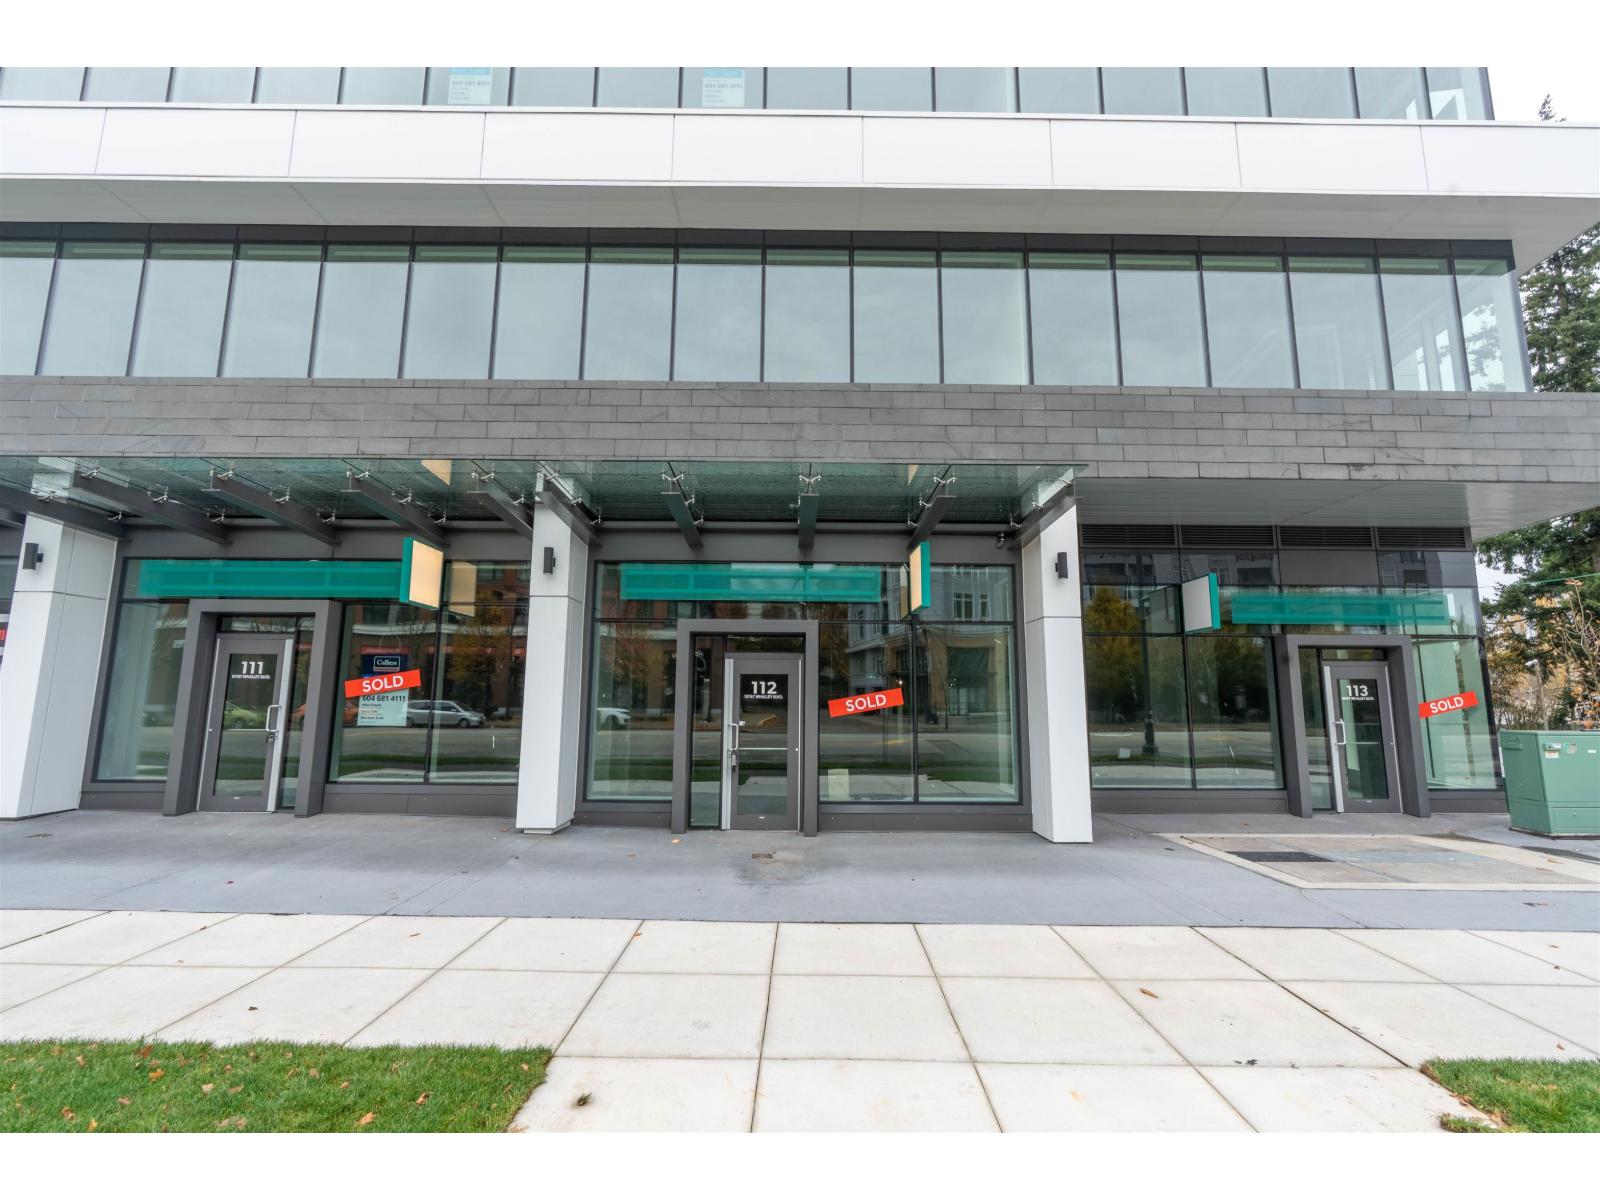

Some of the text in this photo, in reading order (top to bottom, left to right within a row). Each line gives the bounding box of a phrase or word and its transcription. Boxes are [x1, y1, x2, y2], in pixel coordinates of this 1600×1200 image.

[241, 661, 264, 674] 111
[362, 675, 404, 692] SOLD
[751, 681, 777, 694] 112
[1346, 685, 1369, 697] 113
[845, 694, 887, 712] SOLD
[1430, 696, 1464, 714] SOLD
